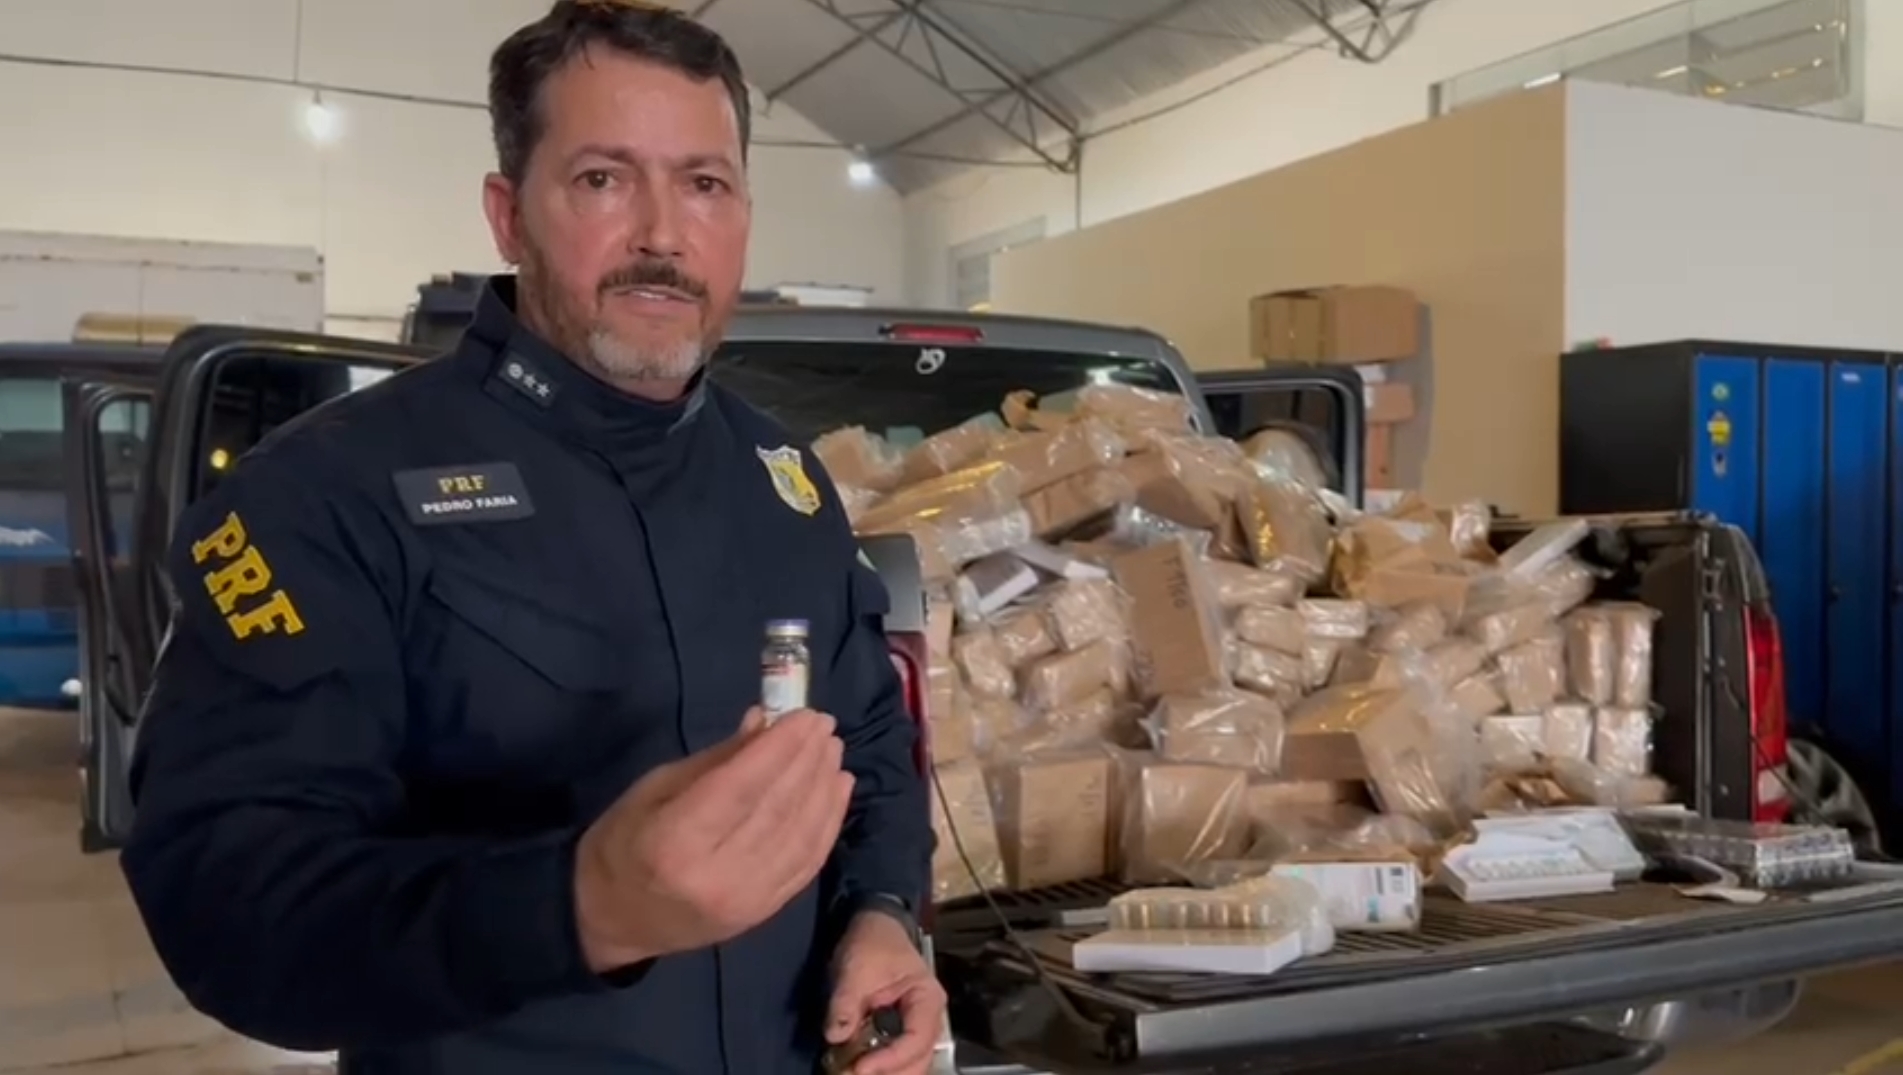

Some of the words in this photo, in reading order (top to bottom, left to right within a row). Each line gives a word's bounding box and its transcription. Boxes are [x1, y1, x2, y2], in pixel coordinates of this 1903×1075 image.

[439, 475, 484, 493] PRF
[422, 499, 473, 514] PEDRO
[476, 495, 518, 508] FARIA
[192, 511, 305, 639] PRF
